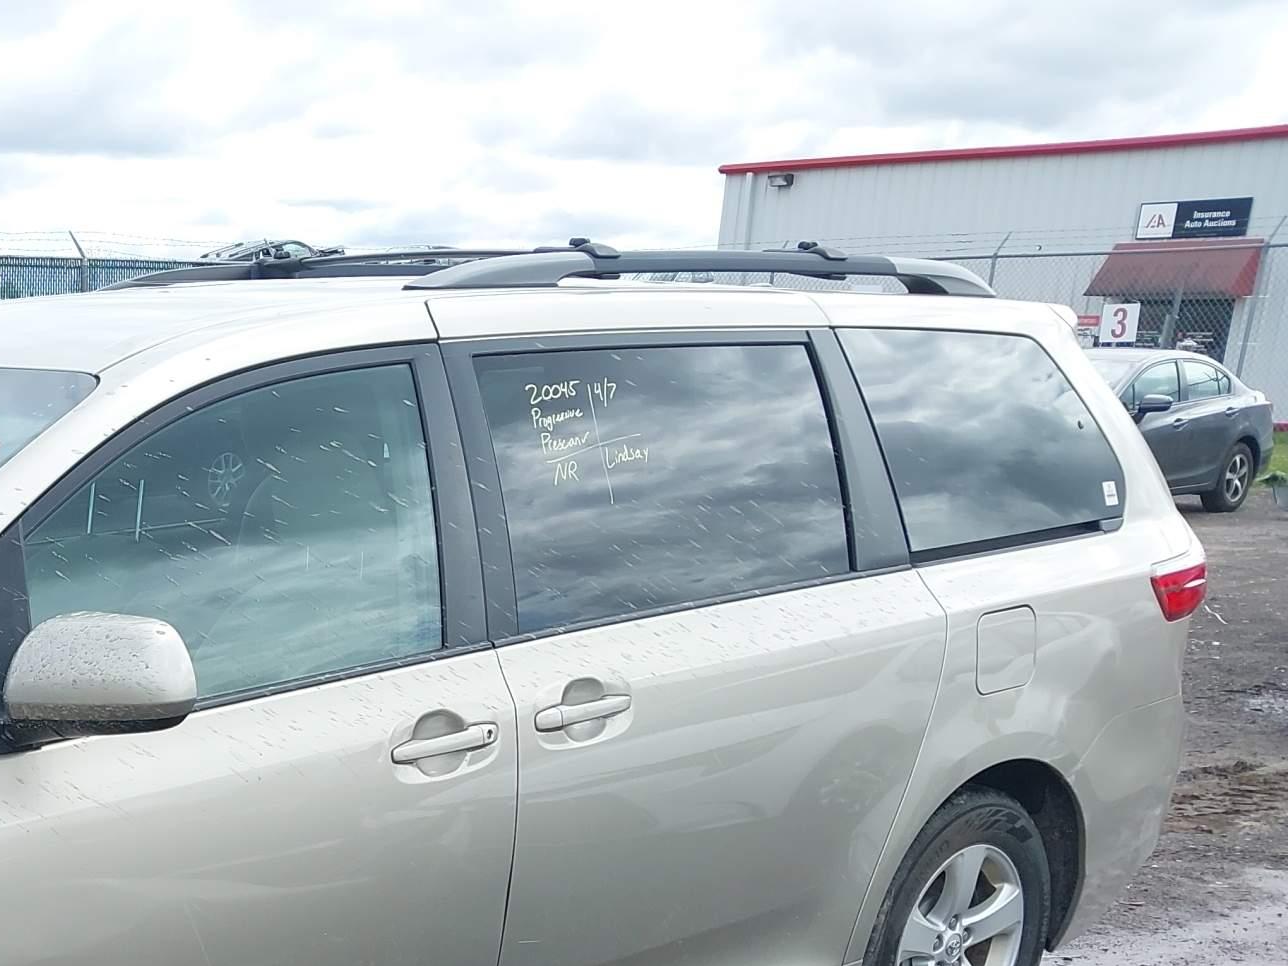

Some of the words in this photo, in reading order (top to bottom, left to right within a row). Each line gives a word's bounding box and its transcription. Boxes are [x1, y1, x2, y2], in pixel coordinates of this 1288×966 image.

[1184, 220, 1202, 229] Auto
[1203, 218, 1237, 228] Auctions
[1193, 210, 1231, 219] Insurance
[1110, 306, 1129, 339] 3
[524, 379, 581, 405] 20045
[593, 376, 617, 407] 4/7
[531, 407, 584, 431] Progressive
[605, 443, 649, 469] Lindsay
[554, 461, 579, 486] NR
